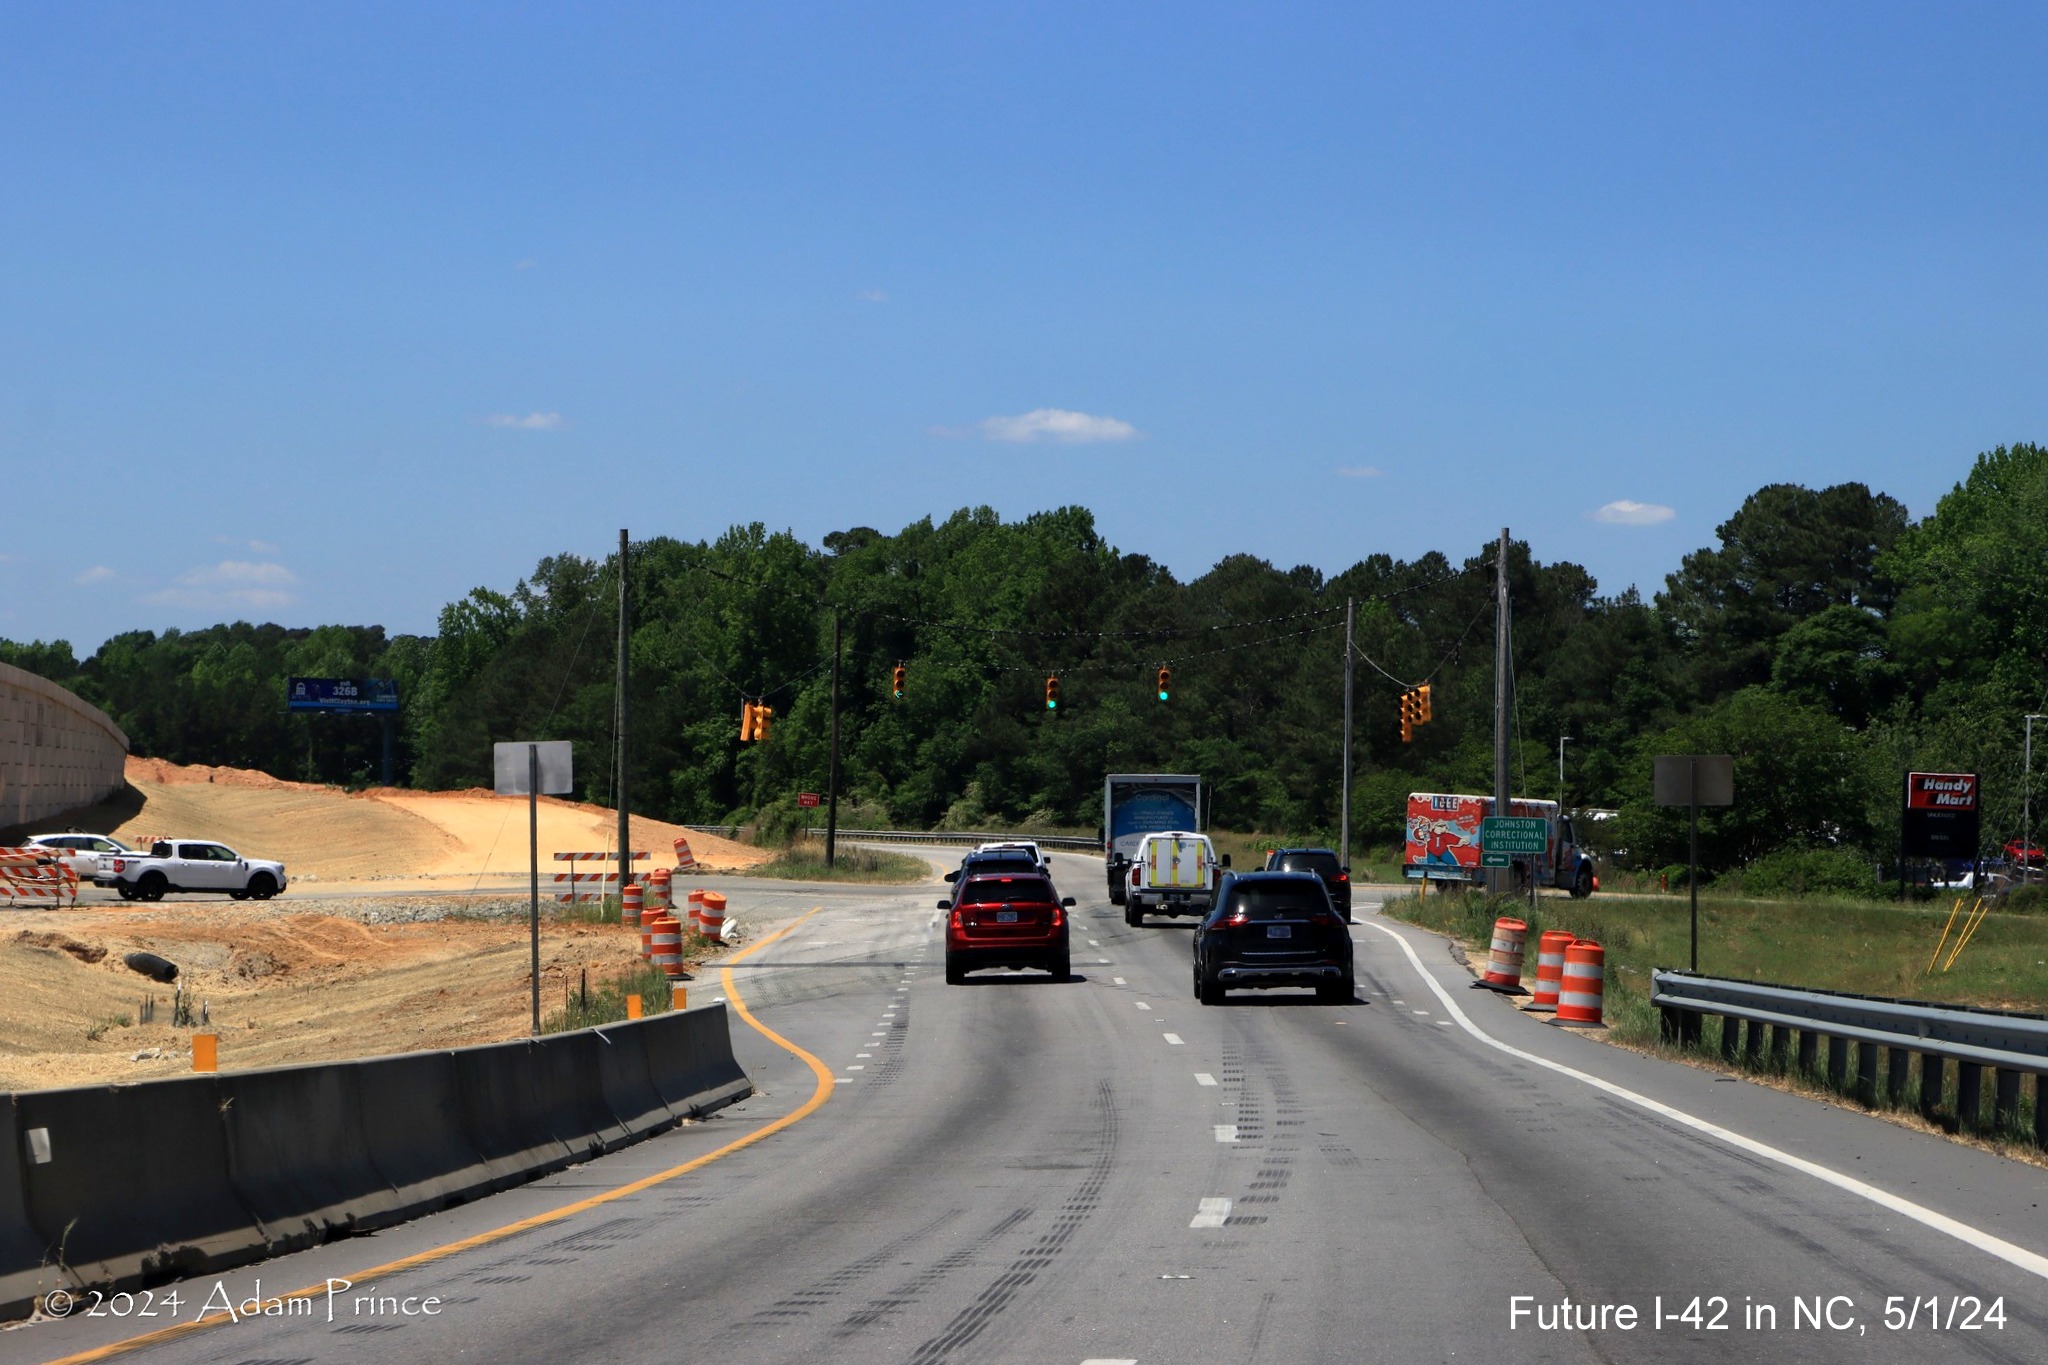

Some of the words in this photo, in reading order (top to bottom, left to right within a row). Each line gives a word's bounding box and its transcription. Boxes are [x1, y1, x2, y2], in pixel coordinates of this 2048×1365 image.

[333, 686, 358, 696] 326B
[1923, 778, 1972, 793] Handy
[1434, 797, 1458, 809] ICEE
[1935, 793, 1973, 806] Mart
[1494, 820, 1537, 829] JOHNSTON
[1485, 830, 1545, 840] CORRECTIONAL
[1491, 841, 1539, 850] INSTITUTION
